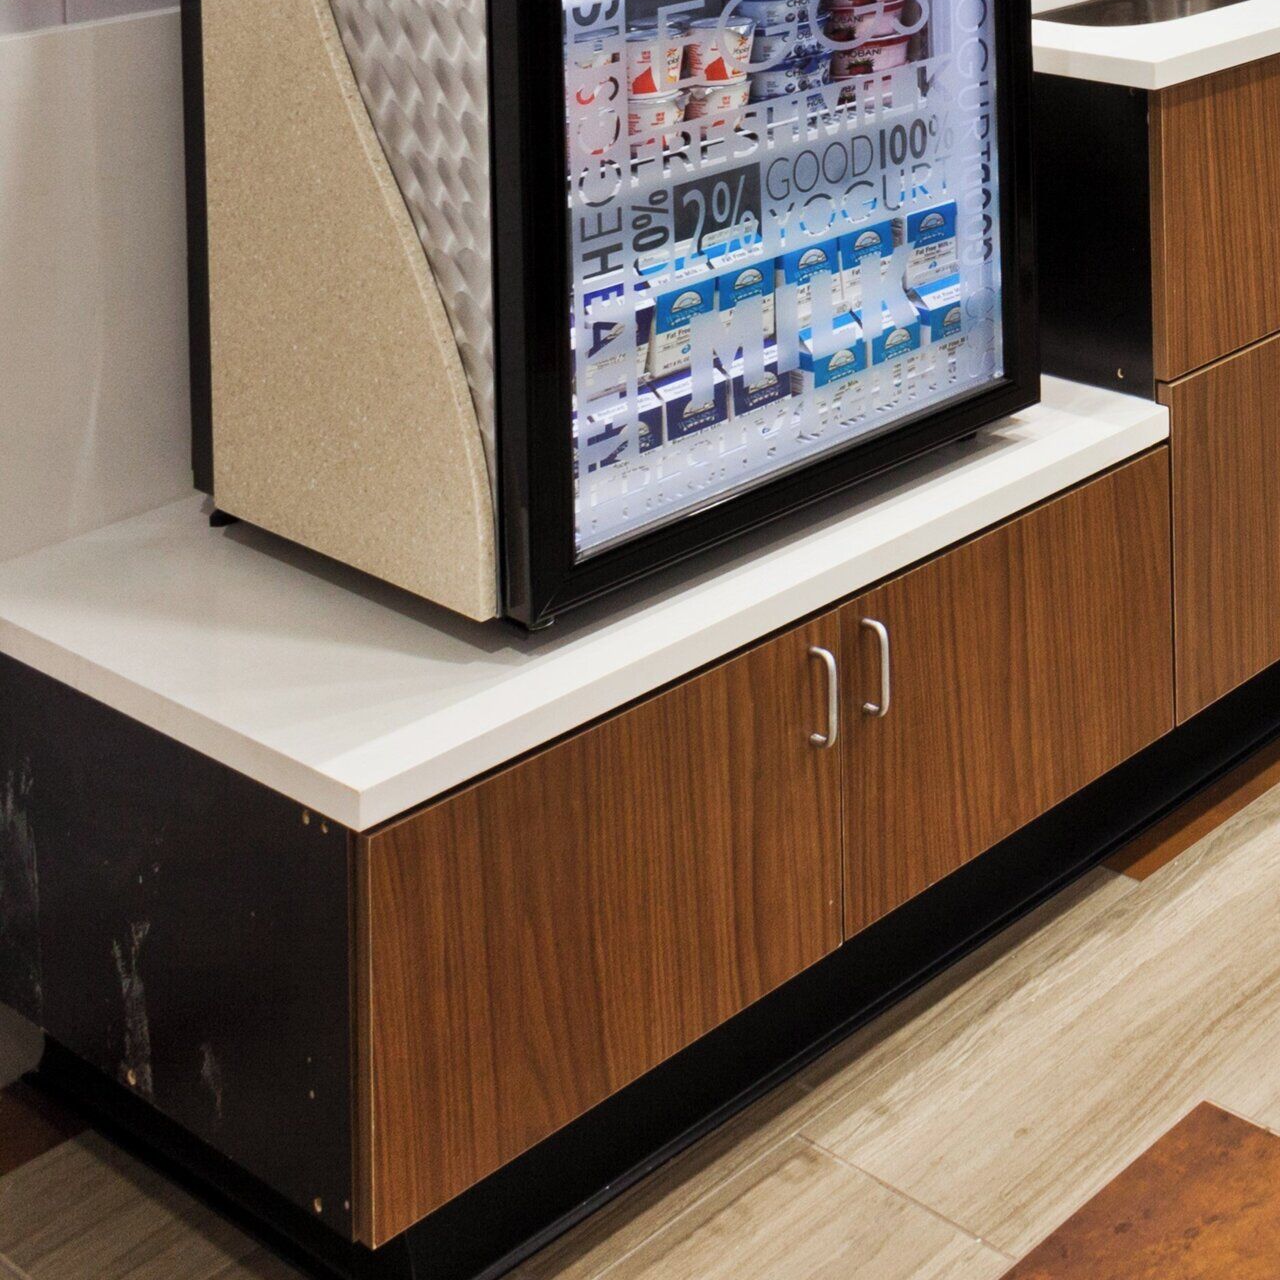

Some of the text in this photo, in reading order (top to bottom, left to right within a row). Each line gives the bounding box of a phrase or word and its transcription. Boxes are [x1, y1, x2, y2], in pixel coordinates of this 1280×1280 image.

[766, 111, 954, 202] GOOD 100%
[769, 156, 958, 248] YOGURT
[682, 174, 760, 266] 2%
[583, 242, 629, 474] HEALTHY
[666, 331, 677, 340] Fat
[689, 244, 923, 410] MILK
